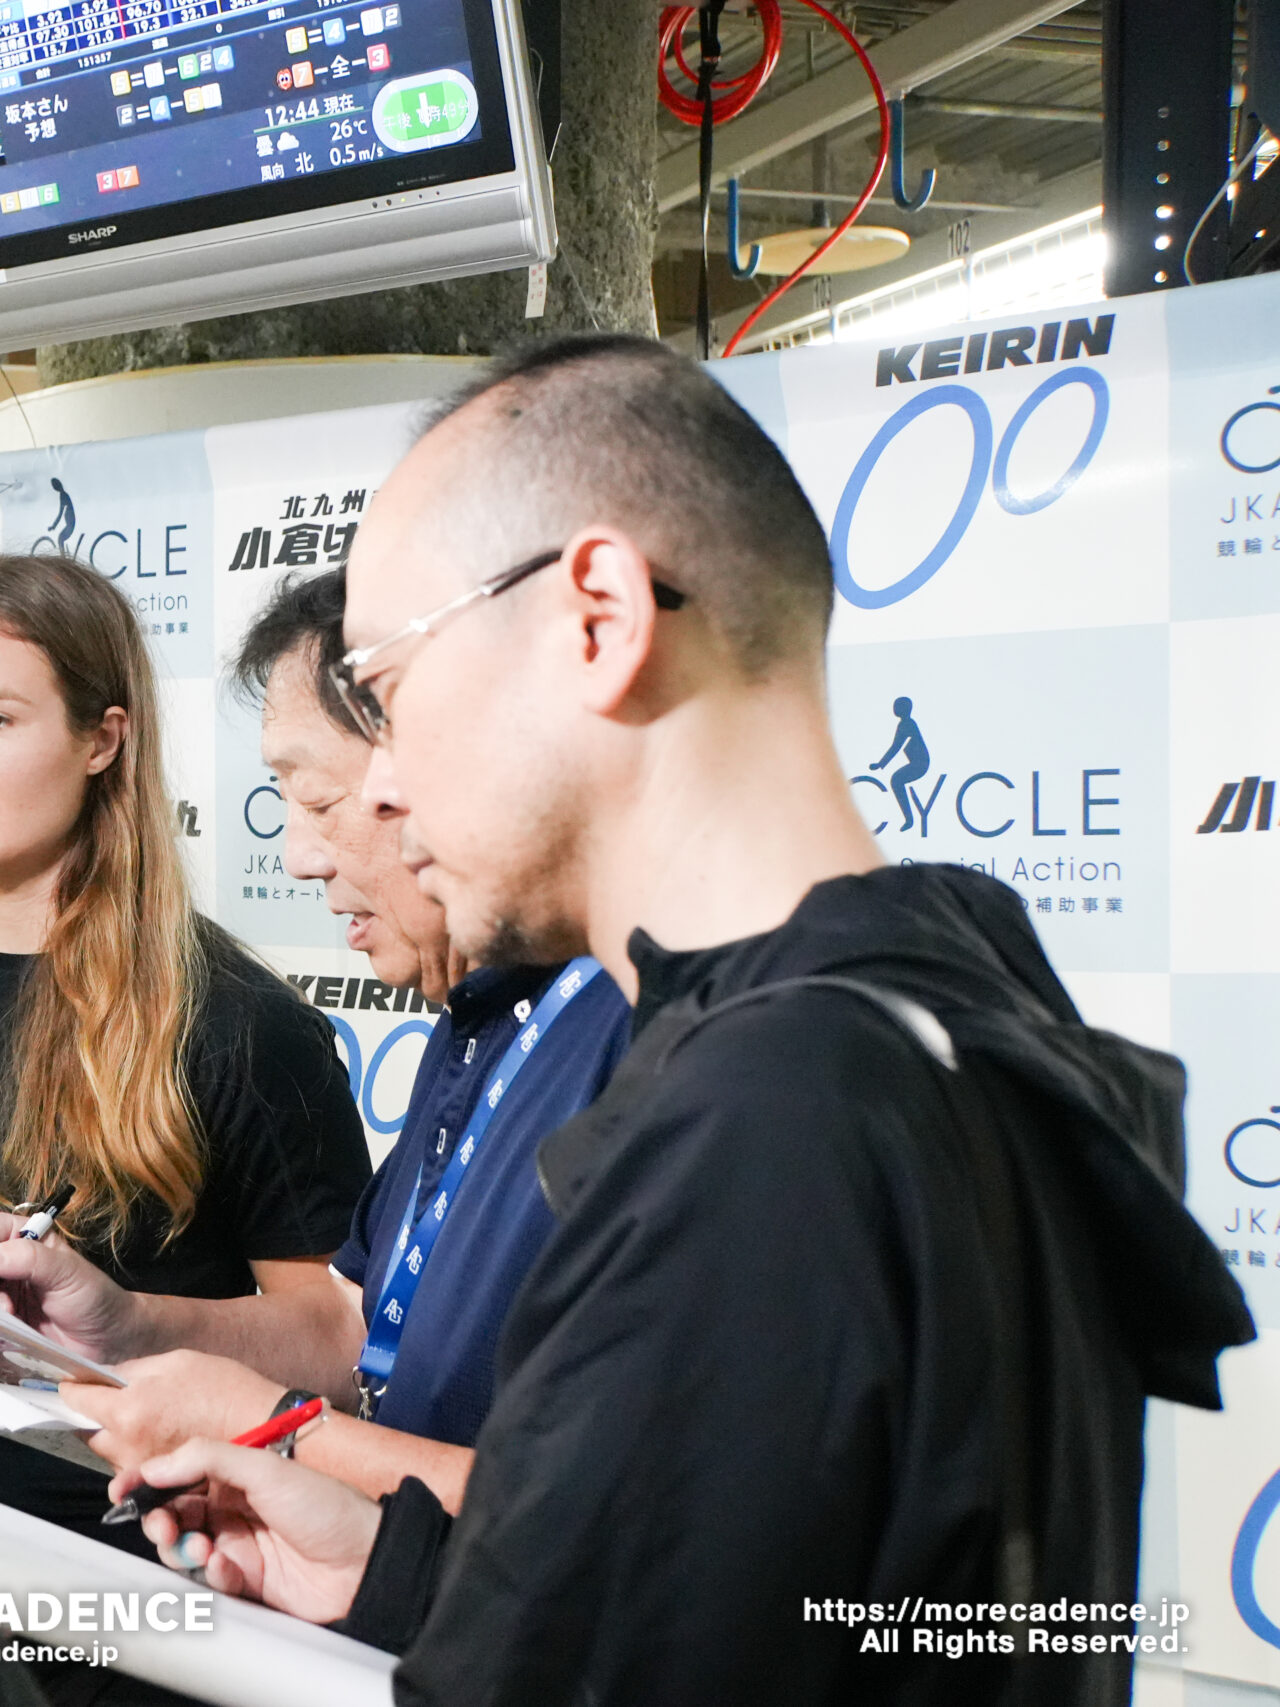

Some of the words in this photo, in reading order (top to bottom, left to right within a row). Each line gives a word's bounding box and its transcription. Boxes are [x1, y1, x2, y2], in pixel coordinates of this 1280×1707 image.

[36, 25, 70, 43] 97.30
[77, 12, 118, 32] 101.84
[126, 1, 162, 20] 96.70
[37, 11, 63, 28] 3.92
[81, 0, 109, 16] 3.92
[42, 41, 68, 57] 15.7
[87, 29, 114, 47] 21.0
[133, 17, 161, 35] 19.3
[180, 5, 208, 22] 32.1
[77, 51, 112, 68] 151357
[5, 94, 68, 124] 坂本さん
[265, 98, 320, 129] 12:44
[323, 94, 354, 114] 現在
[25, 119, 56, 143] 予想
[295, 152, 314, 174] 北
[68, 226, 117, 244] SHARP
[947, 219, 970, 258] 102
[875, 313, 1117, 387] KEIRIN
[279, 488, 370, 520] 北九州
[129, 592, 188, 612] ction
[245, 854, 284, 875] JKA
[1012, 856, 1122, 881] Action
